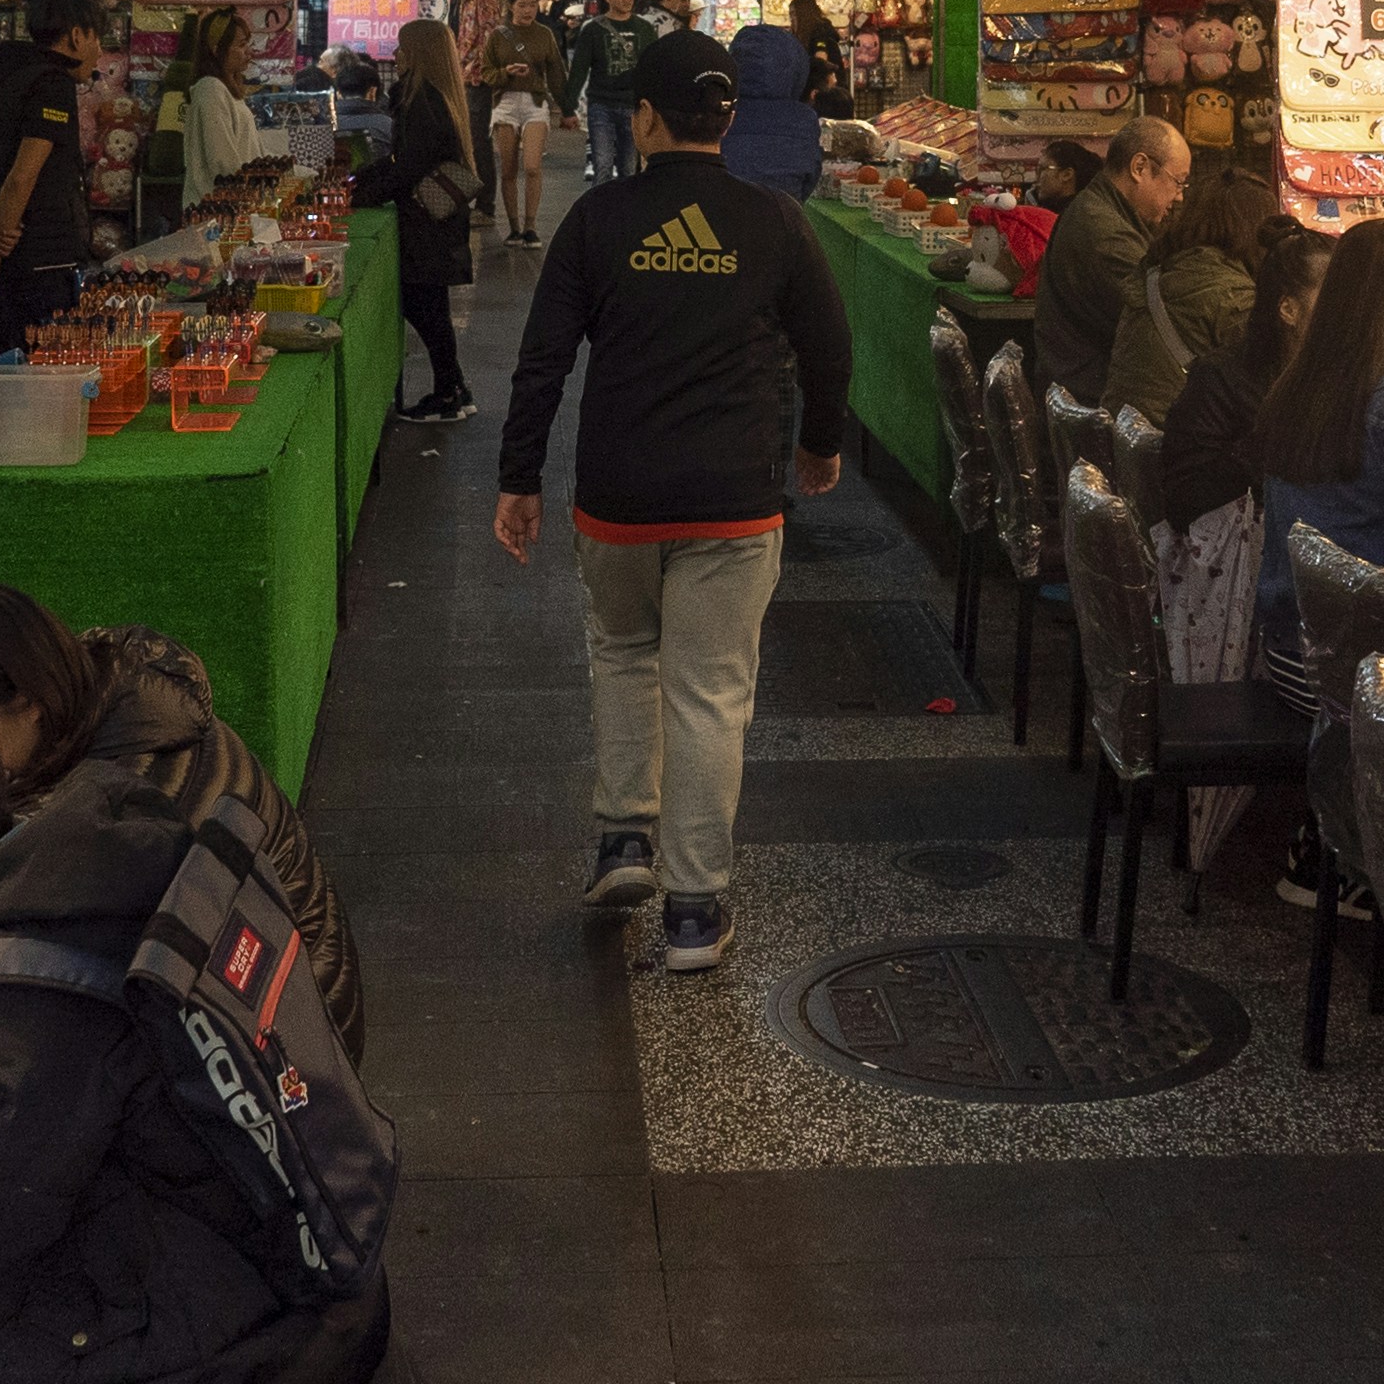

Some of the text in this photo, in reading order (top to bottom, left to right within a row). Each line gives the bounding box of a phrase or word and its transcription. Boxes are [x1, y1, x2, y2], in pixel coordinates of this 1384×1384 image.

[335, 18, 406, 41] 7局100
[1292, 114, 1320, 124] Small
[629, 245, 738, 274] adidas
[229, 936, 248, 973] SUPER
[237, 948, 250, 973] DRY
